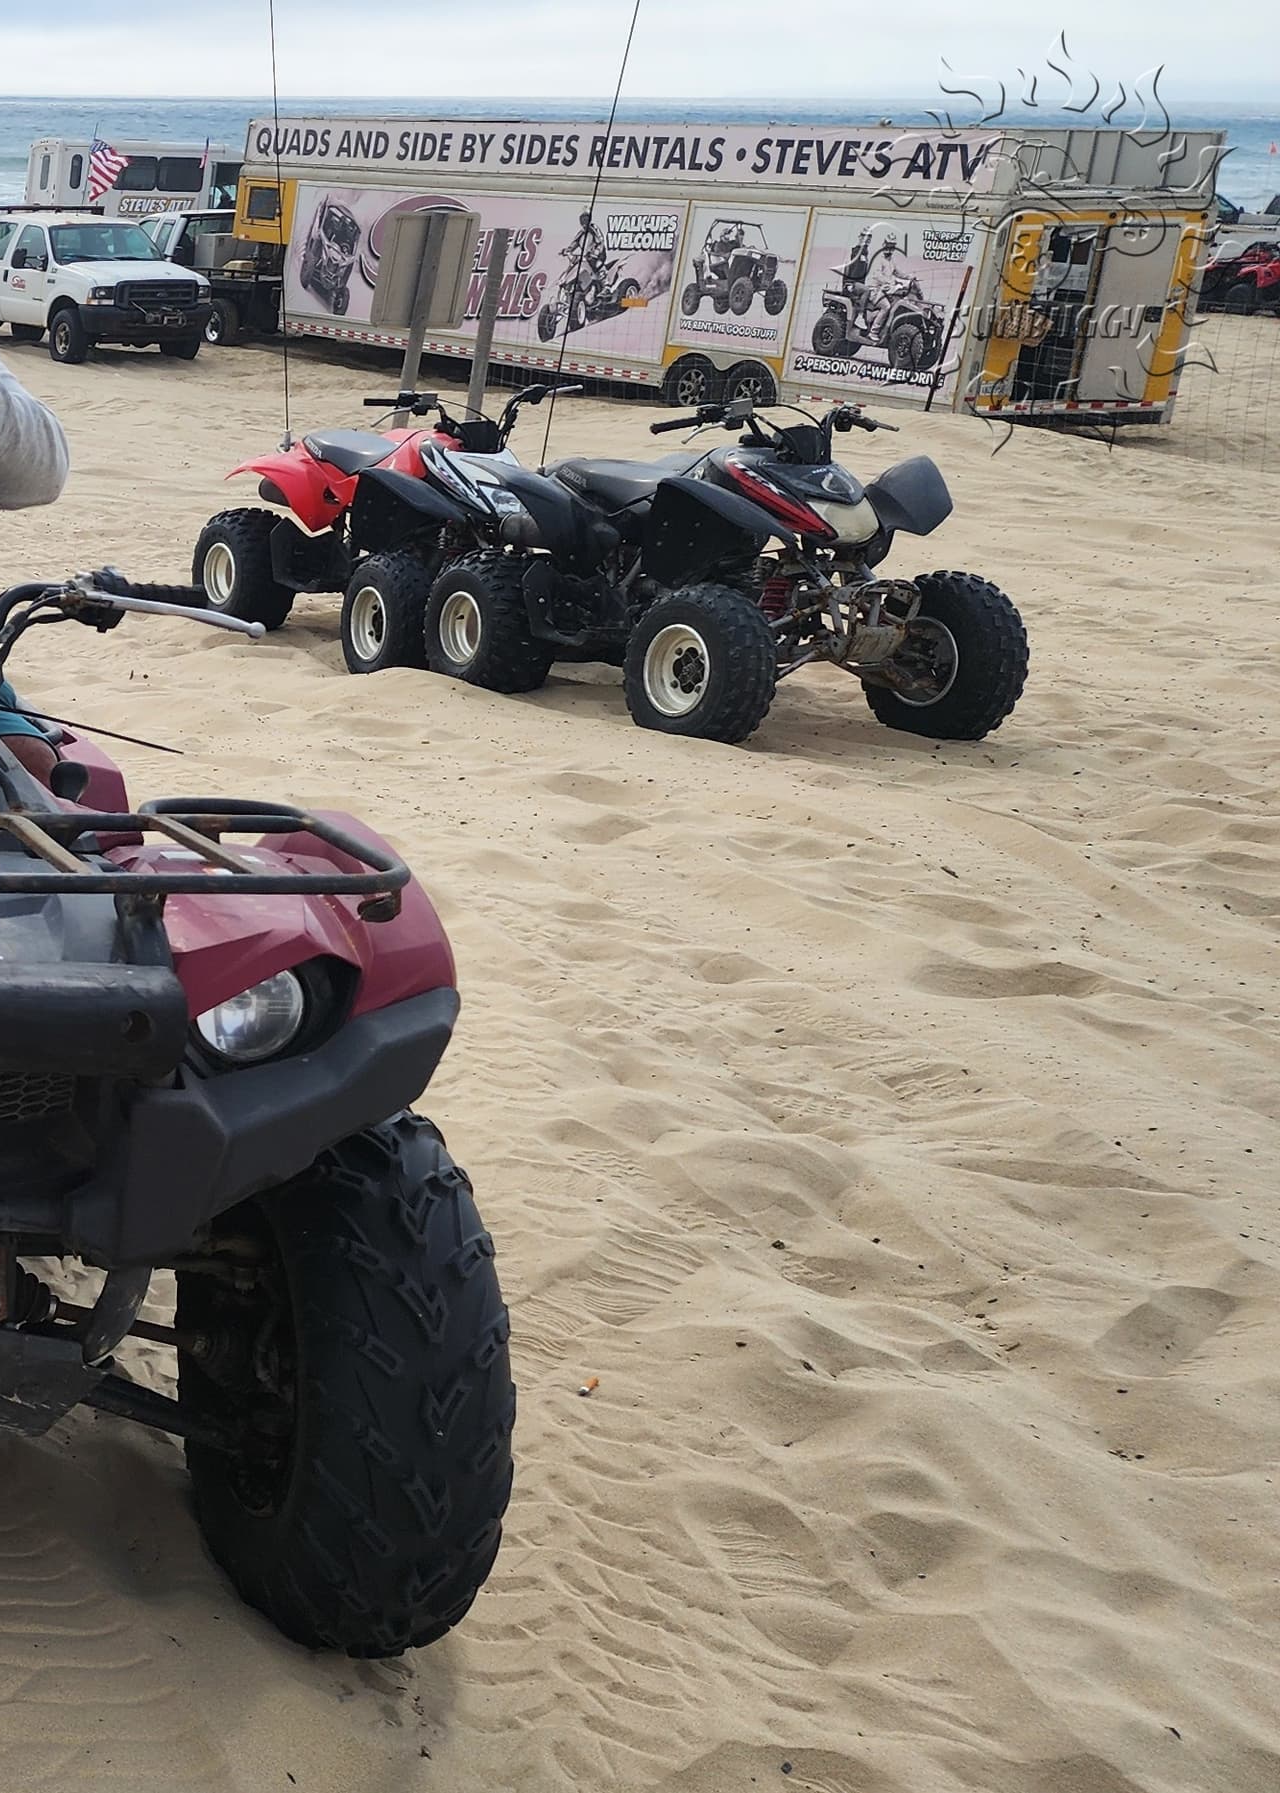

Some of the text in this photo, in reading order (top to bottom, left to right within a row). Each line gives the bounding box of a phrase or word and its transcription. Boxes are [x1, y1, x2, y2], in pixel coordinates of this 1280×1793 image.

[256, 127, 988, 181] QUADS AND SIDE BY SIDES RENTALS STEVE'S ATV
[120, 198, 166, 212] STEVE'S
[608, 215, 678, 232] WALK-UPS
[607, 232, 674, 250] WELCOME
[925, 240, 968, 252] QUAD FOR
[711, 322, 726, 334] THE
[726, 324, 751, 337] GOOD
[795, 357, 849, 375] 2-PERSON
[559, 465, 587, 488] HONDA
